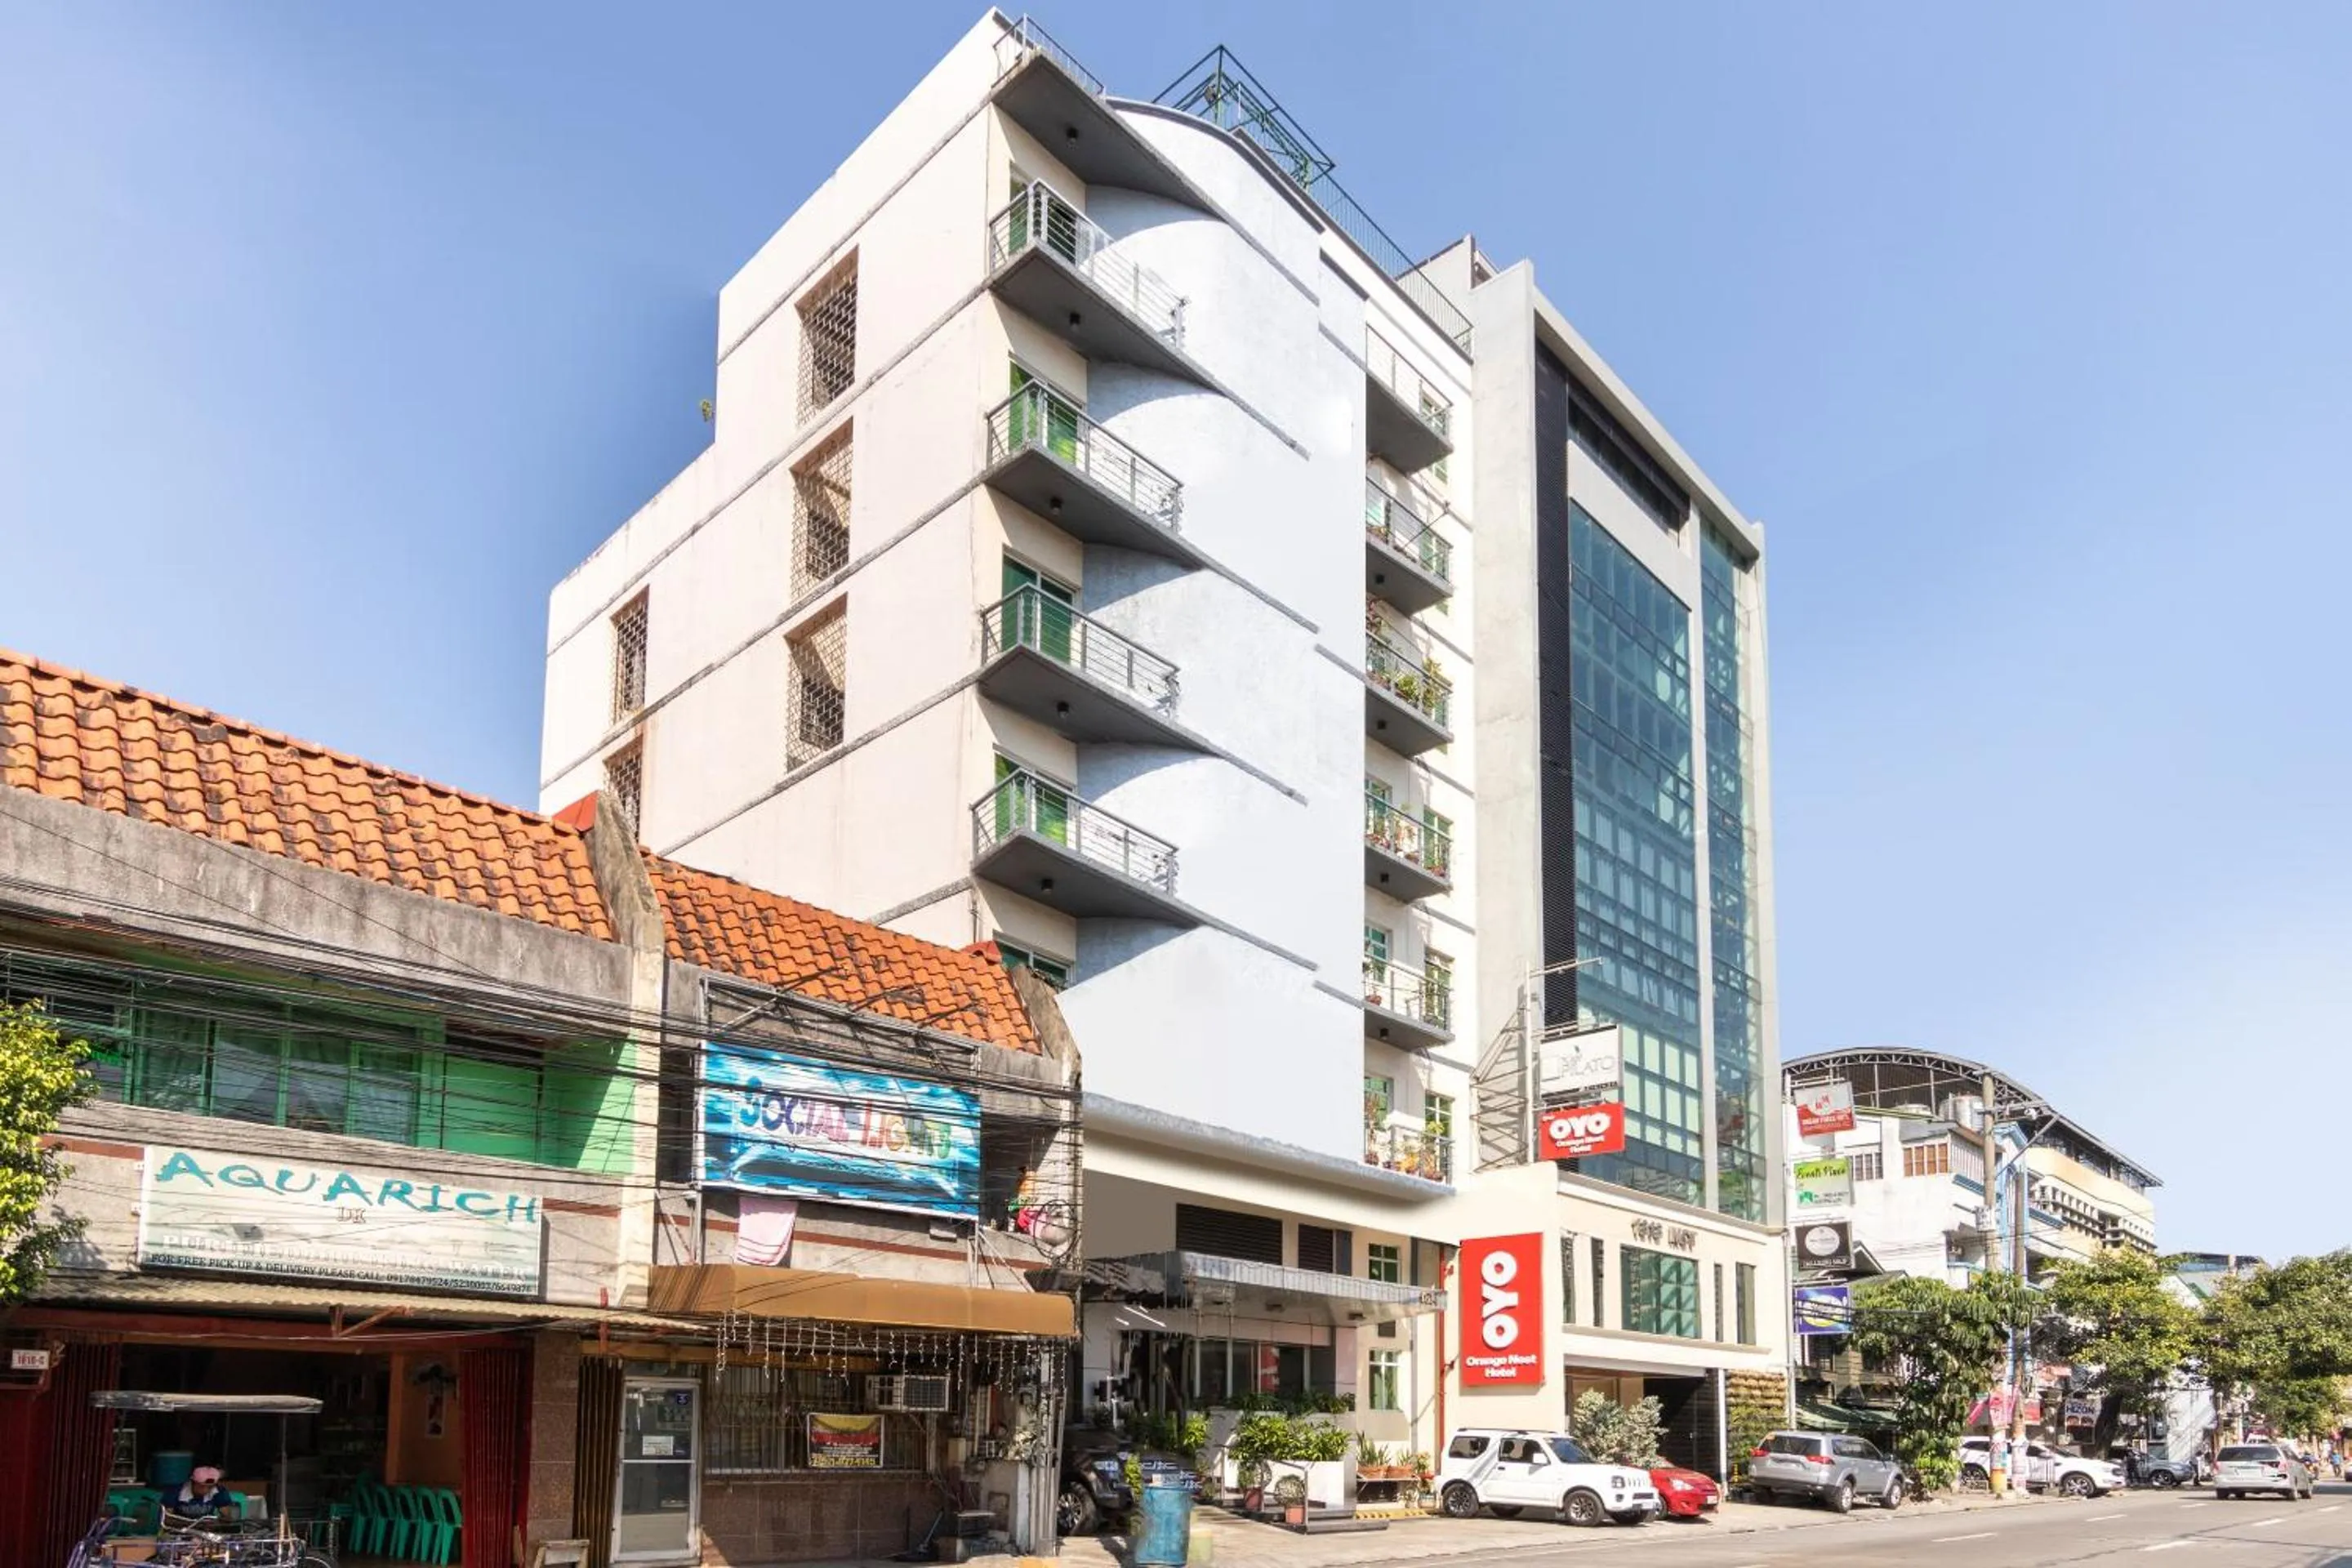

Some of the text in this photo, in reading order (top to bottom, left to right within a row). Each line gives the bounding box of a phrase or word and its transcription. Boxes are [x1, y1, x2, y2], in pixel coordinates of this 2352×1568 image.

[1548, 1111, 1611, 1140] OYO
[154, 1152, 537, 1224] AQUARICH
[265, 1263, 317, 1275] DELIVERY
[1481, 1250, 1520, 1349] OYO
[1466, 1353, 1538, 1369] Orange Nest
[1485, 1367, 1517, 1379] Hotel
